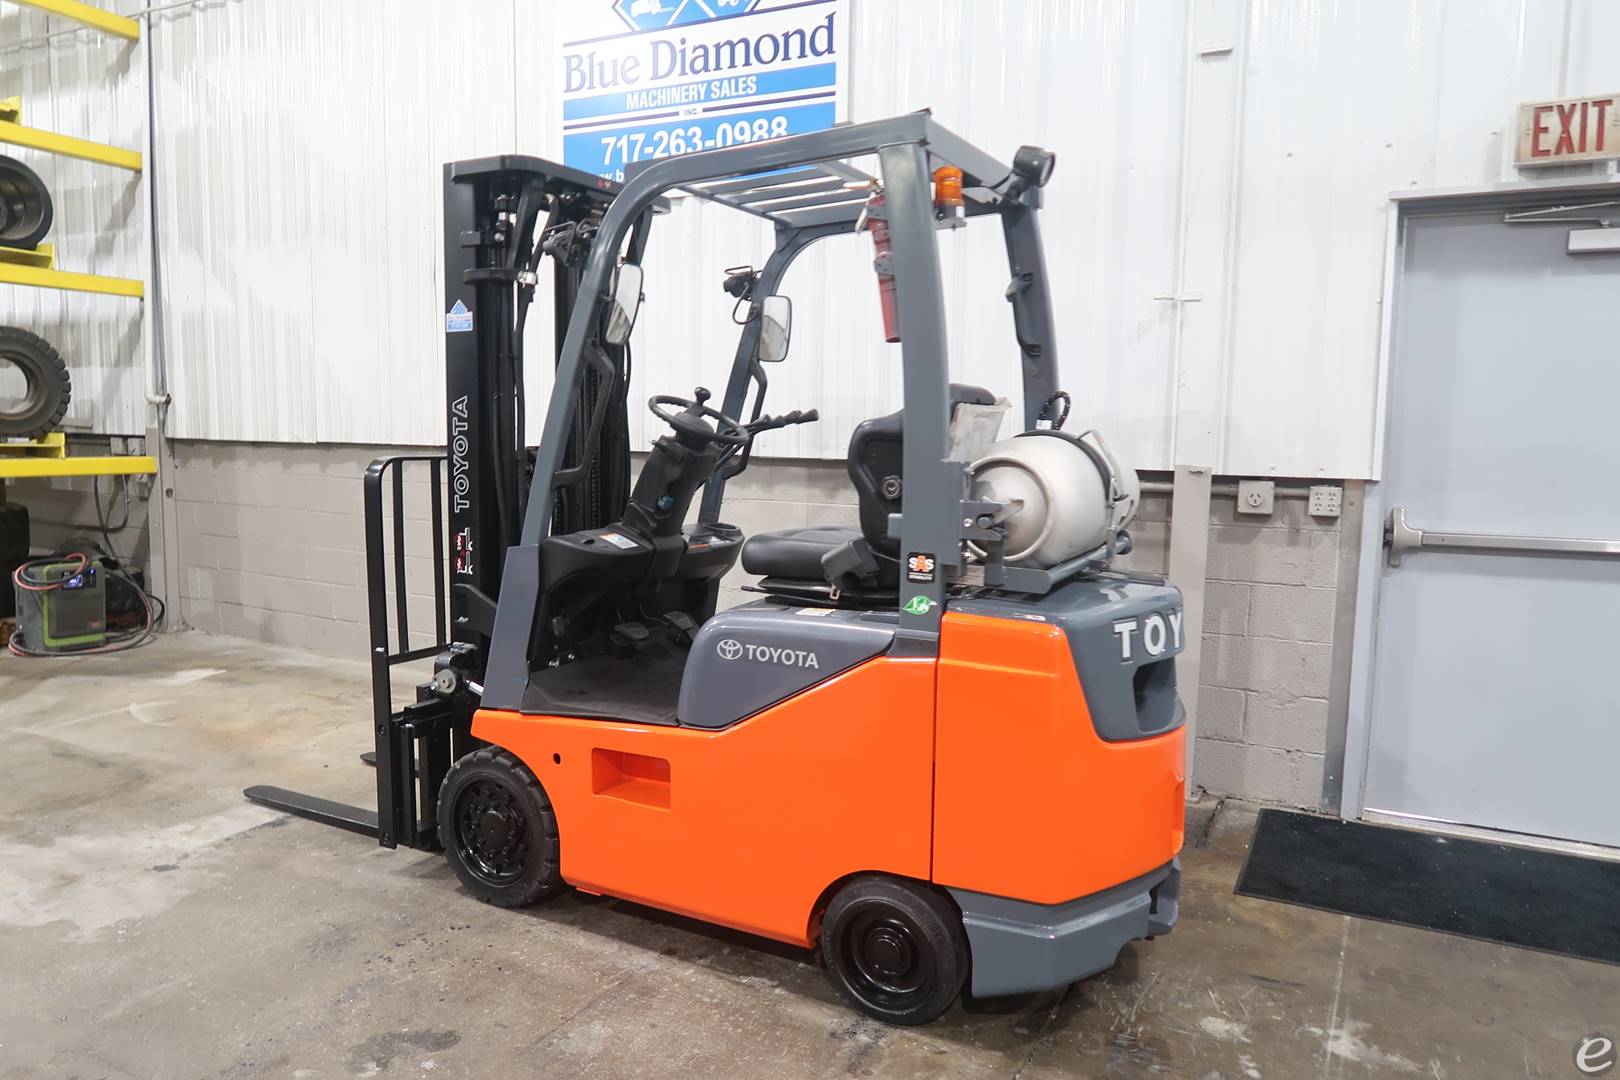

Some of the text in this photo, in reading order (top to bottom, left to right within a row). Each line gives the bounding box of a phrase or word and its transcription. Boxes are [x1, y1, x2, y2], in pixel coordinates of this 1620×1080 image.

[563, 11, 837, 94] Blue Diamond
[626, 76, 757, 111] MACHINERY SALES
[601, 116, 788, 166] 717-263-0988
[1531, 99, 1613, 158] EXIT
[451, 394, 470, 513] TOYOTA
[745, 644, 819, 669] TOYOTA
